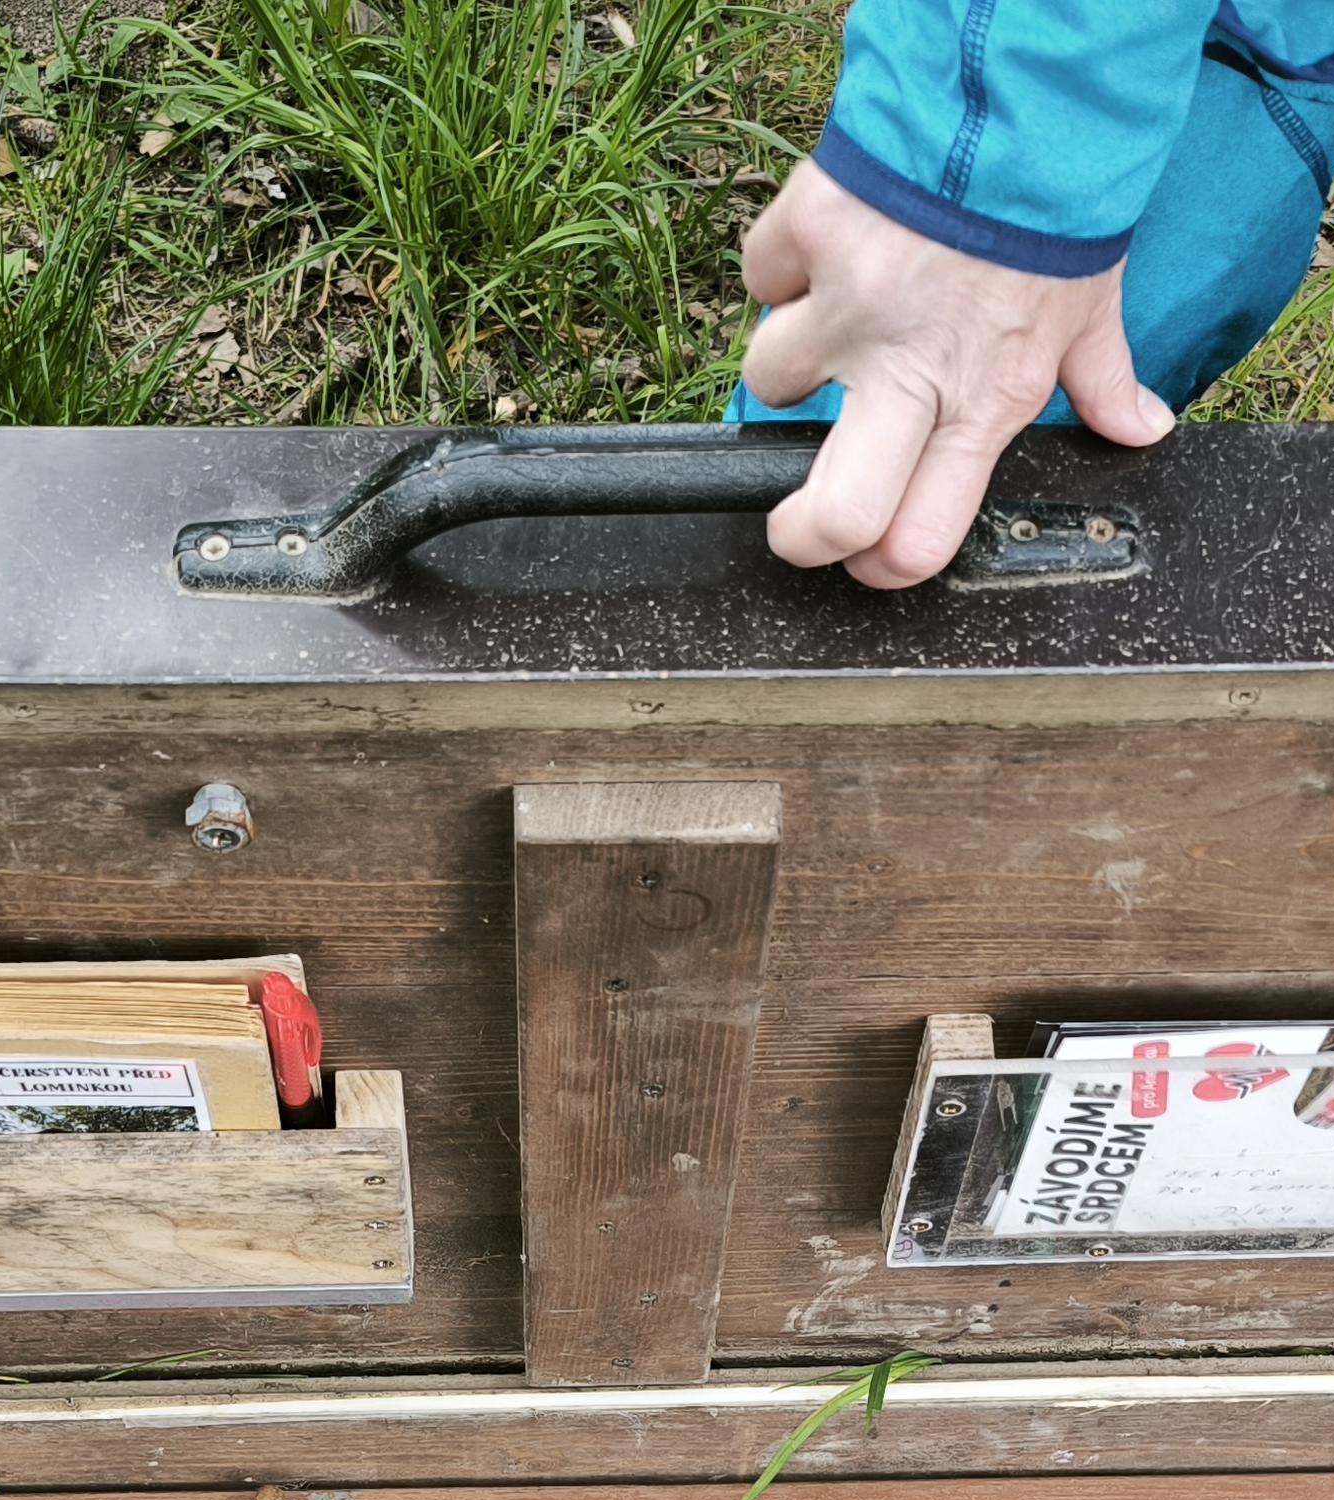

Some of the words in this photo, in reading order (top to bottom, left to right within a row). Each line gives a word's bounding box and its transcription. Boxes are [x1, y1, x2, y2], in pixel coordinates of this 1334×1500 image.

[20, 1082, 133, 1093] LOMINKOU
[1019, 1082, 1122, 1226] ZÁVODÍME
[1074, 1124, 1154, 1224] SRDCEM
